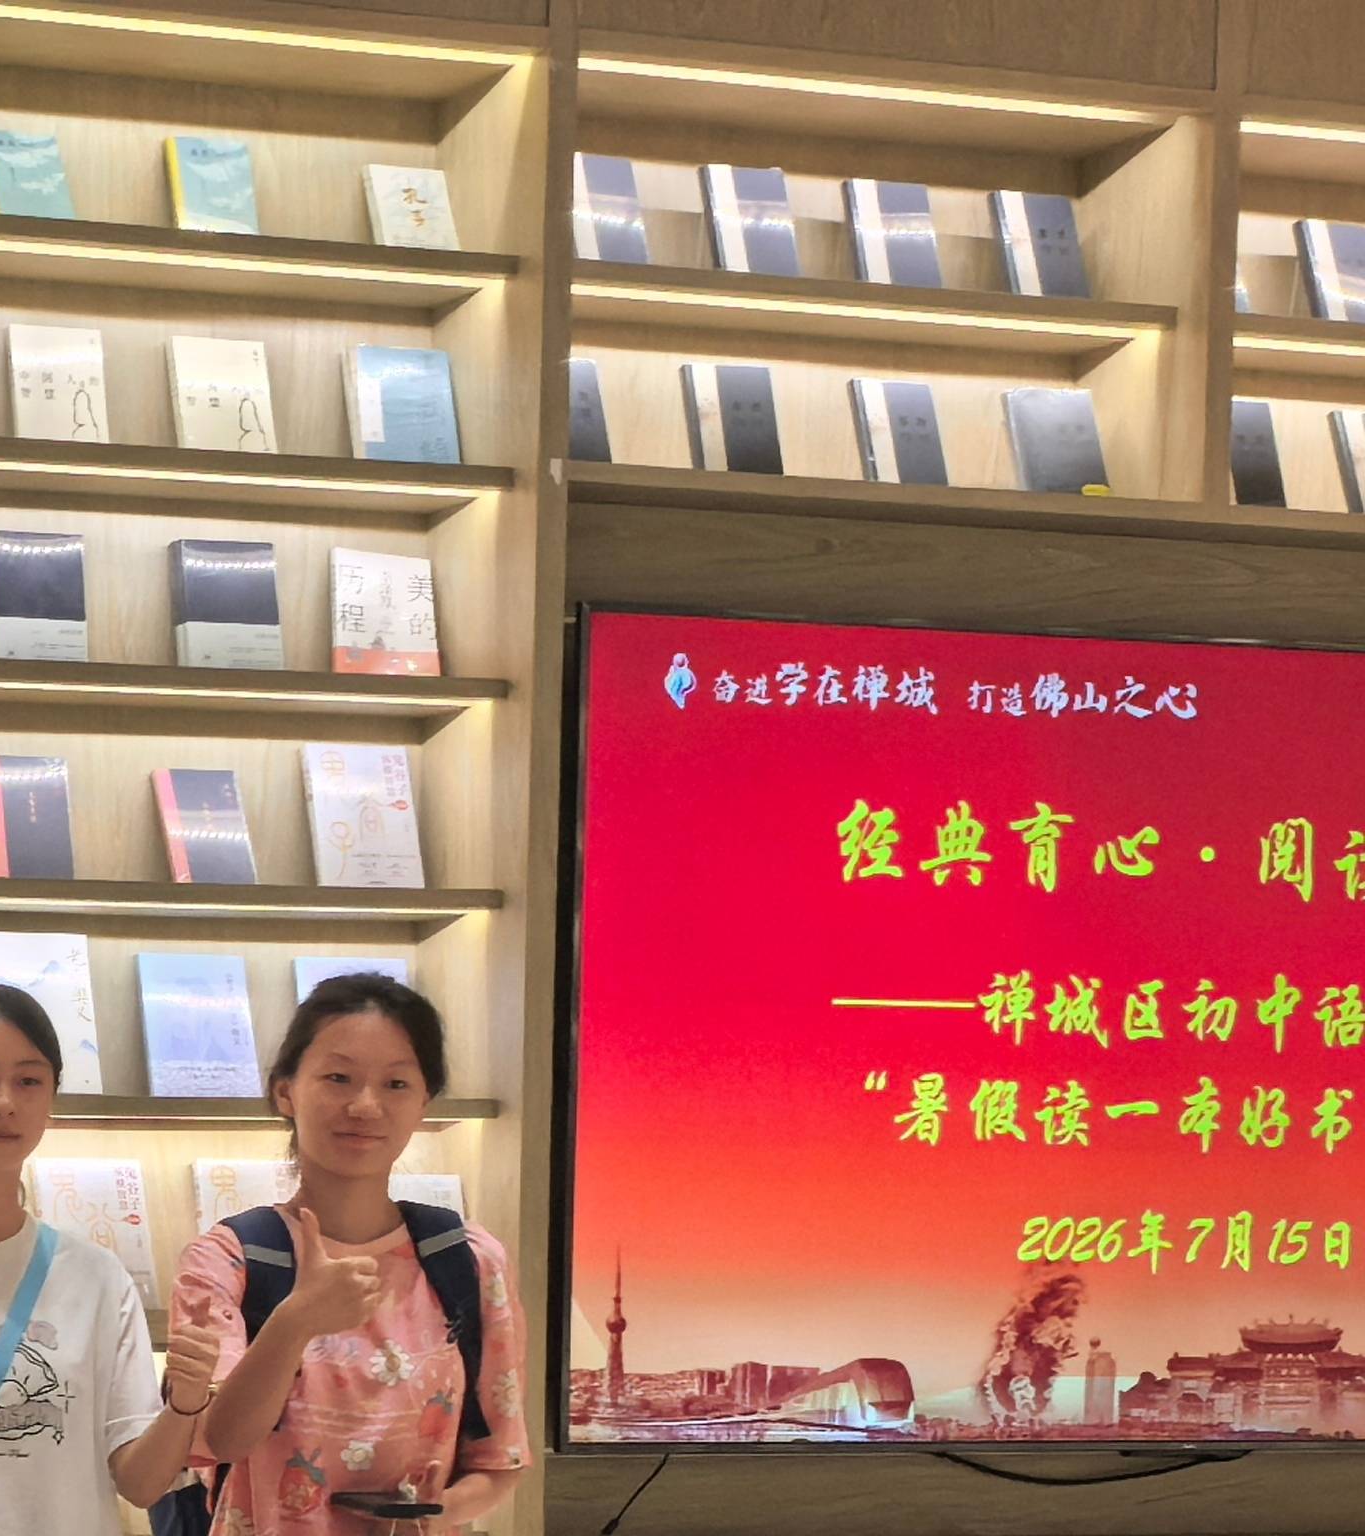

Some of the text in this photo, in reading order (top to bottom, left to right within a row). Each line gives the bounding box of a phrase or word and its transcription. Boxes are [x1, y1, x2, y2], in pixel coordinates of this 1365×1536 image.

[711, 662, 1199, 721] 奋进学在禅城 打造佛山之心
